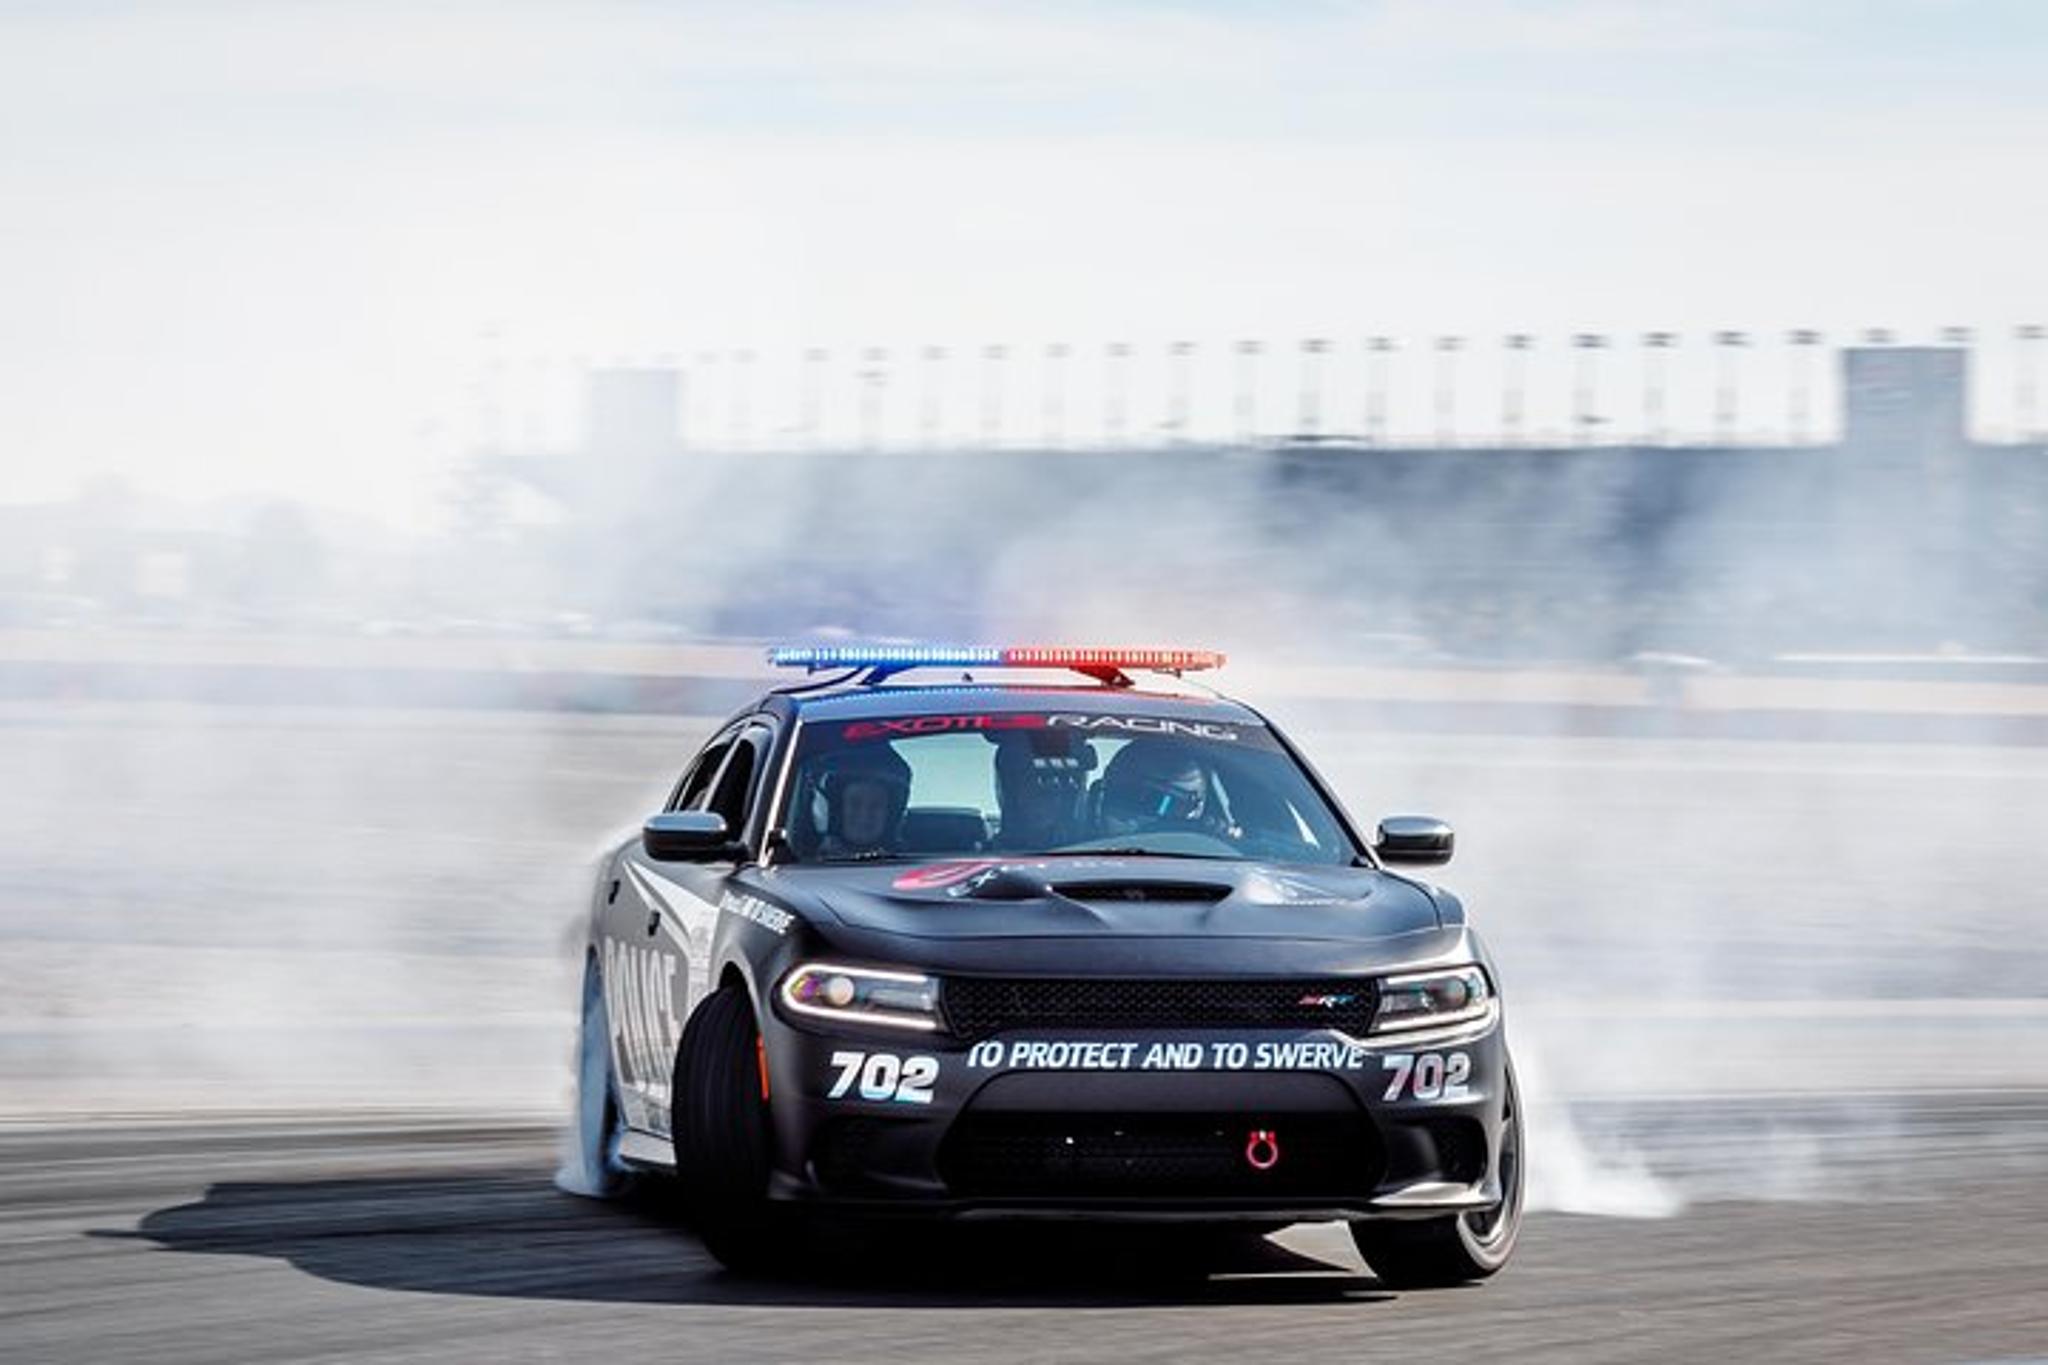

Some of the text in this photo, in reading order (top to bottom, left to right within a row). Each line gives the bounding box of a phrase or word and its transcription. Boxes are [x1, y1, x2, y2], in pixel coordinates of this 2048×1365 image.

[1047, 714, 1238, 741] RACING
[1009, 1042, 1138, 1068] PROTECT
[1141, 1042, 1203, 1069] AND
[1210, 1042, 1249, 1069] TO
[1253, 1042, 1364, 1069] SWERVE
[827, 1051, 939, 1105] 702
[1382, 1052, 1471, 1102] 702
